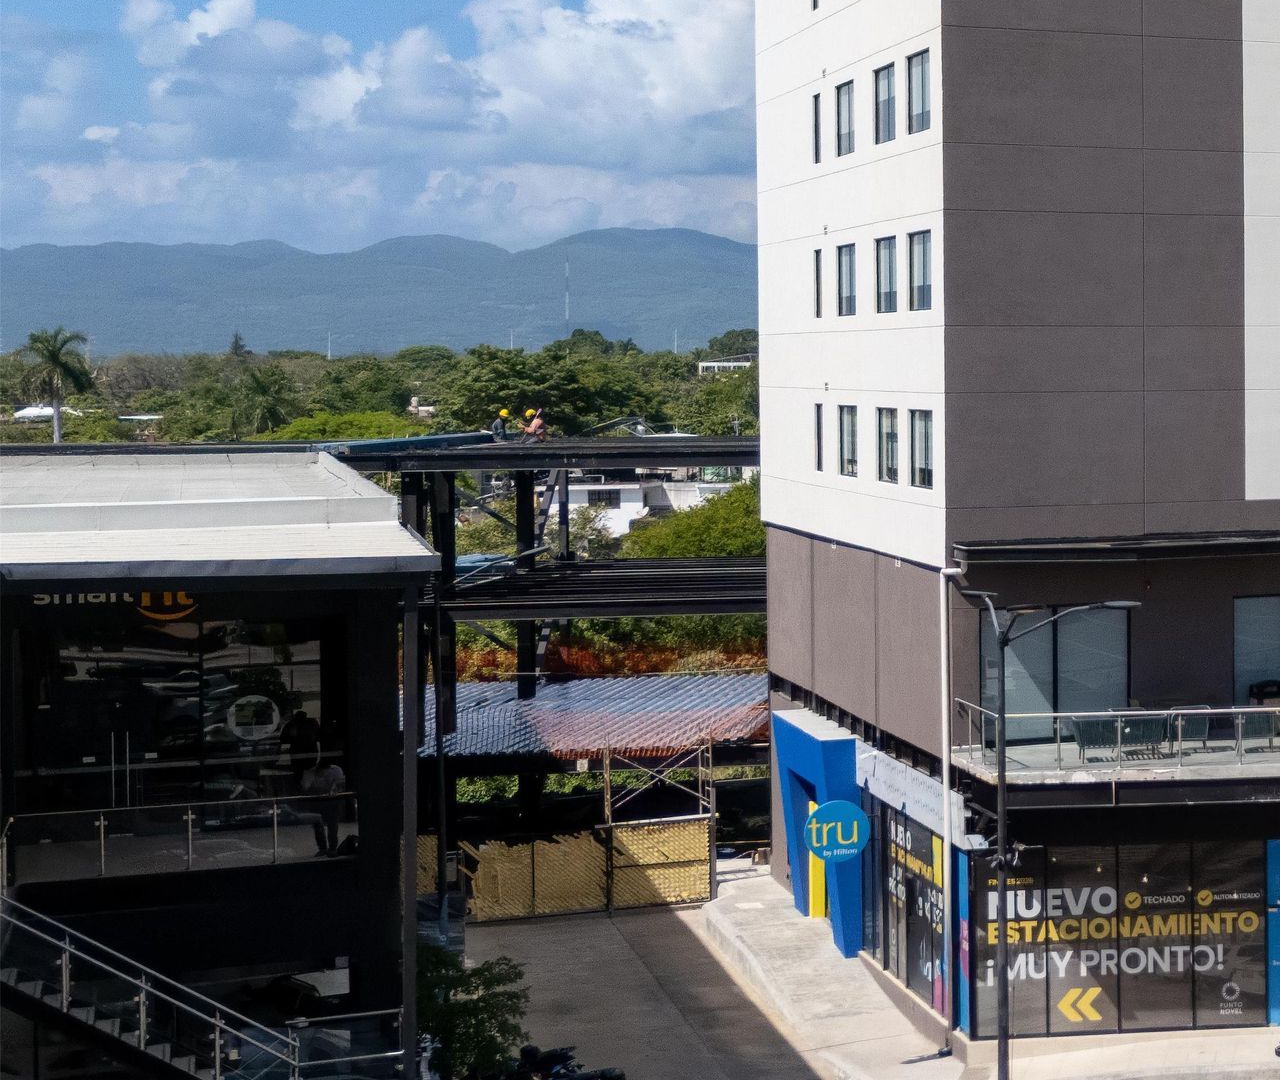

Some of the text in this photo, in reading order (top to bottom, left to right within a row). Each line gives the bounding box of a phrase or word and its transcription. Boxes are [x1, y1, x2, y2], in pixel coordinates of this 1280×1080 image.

[807, 818, 858, 847] tru
[987, 886, 1118, 920] NUEVO
[1143, 895, 1186, 905] TECHADO
[987, 911, 1260, 945] ESTACIONAMIENTO
[1080, 944, 1224, 977] PRONTO!
